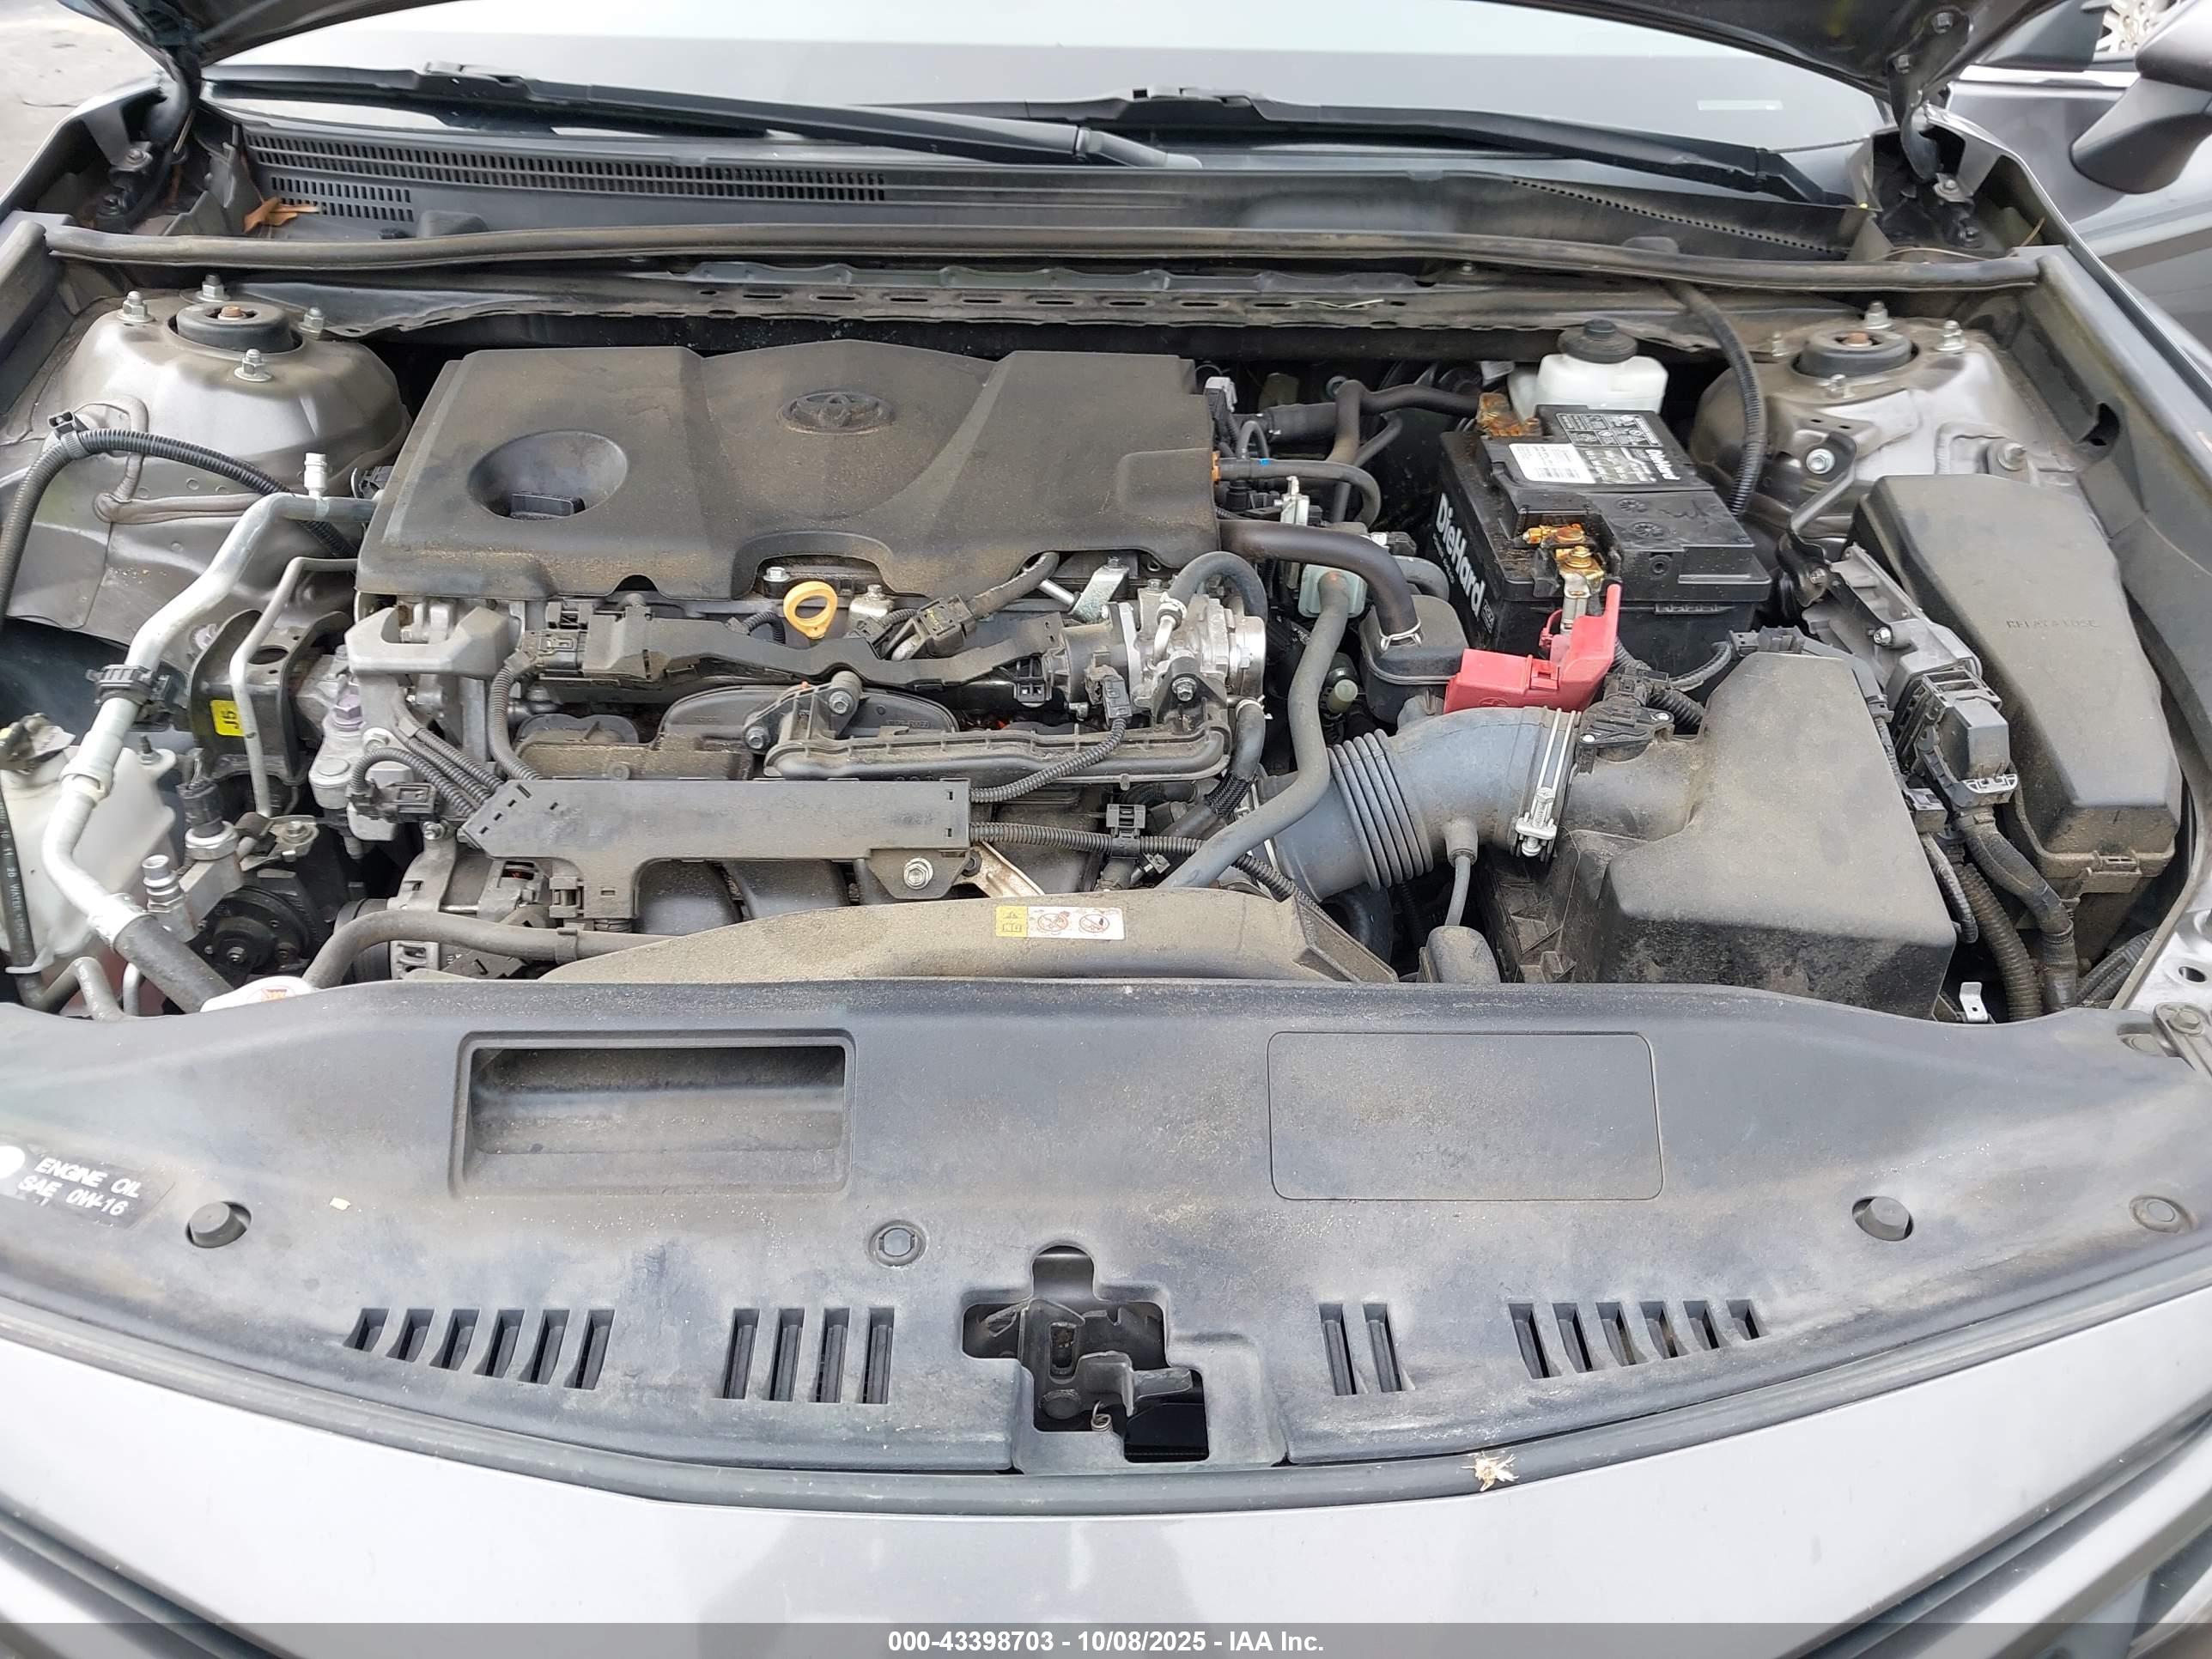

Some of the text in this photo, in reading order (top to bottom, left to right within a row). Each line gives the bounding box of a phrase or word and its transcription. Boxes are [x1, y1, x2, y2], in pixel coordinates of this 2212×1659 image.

[1436, 492, 1486, 621] DieHard
[17, 1175, 129, 1216] SAE 0W-16
[34, 1158, 142, 1198] ENGINE OIL
